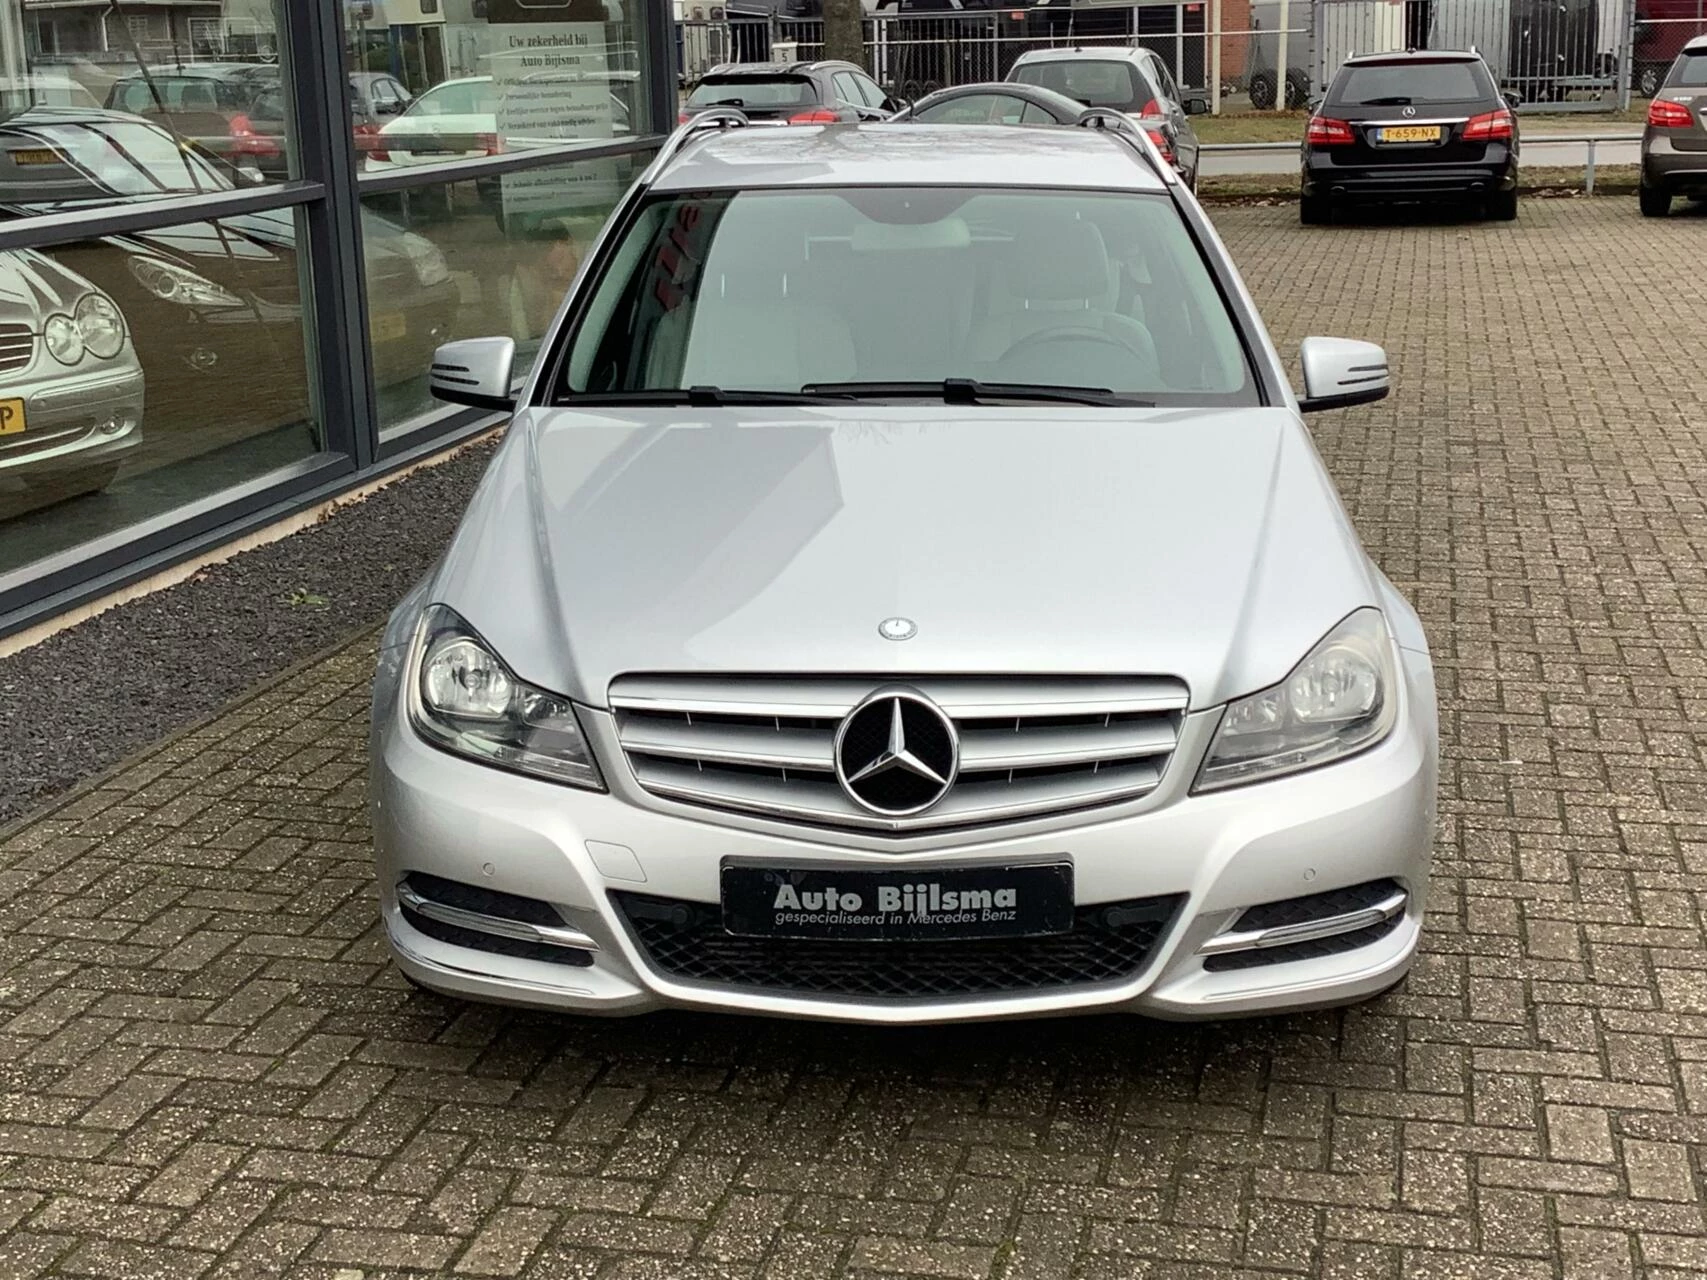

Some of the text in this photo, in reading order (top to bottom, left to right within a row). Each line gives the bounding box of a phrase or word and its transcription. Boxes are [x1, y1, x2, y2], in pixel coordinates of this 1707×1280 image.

[508, 33, 588, 48] Uw zekerheid bij
[520, 53, 580, 68] Auto Bijlsma
[1385, 128, 1436, 138] T-659-NX
[0, 406, 14, 430] P
[773, 883, 1017, 917] Auto Bijlsma
[775, 908, 1017, 926] gespecialiseerd in Mercedes Benz
